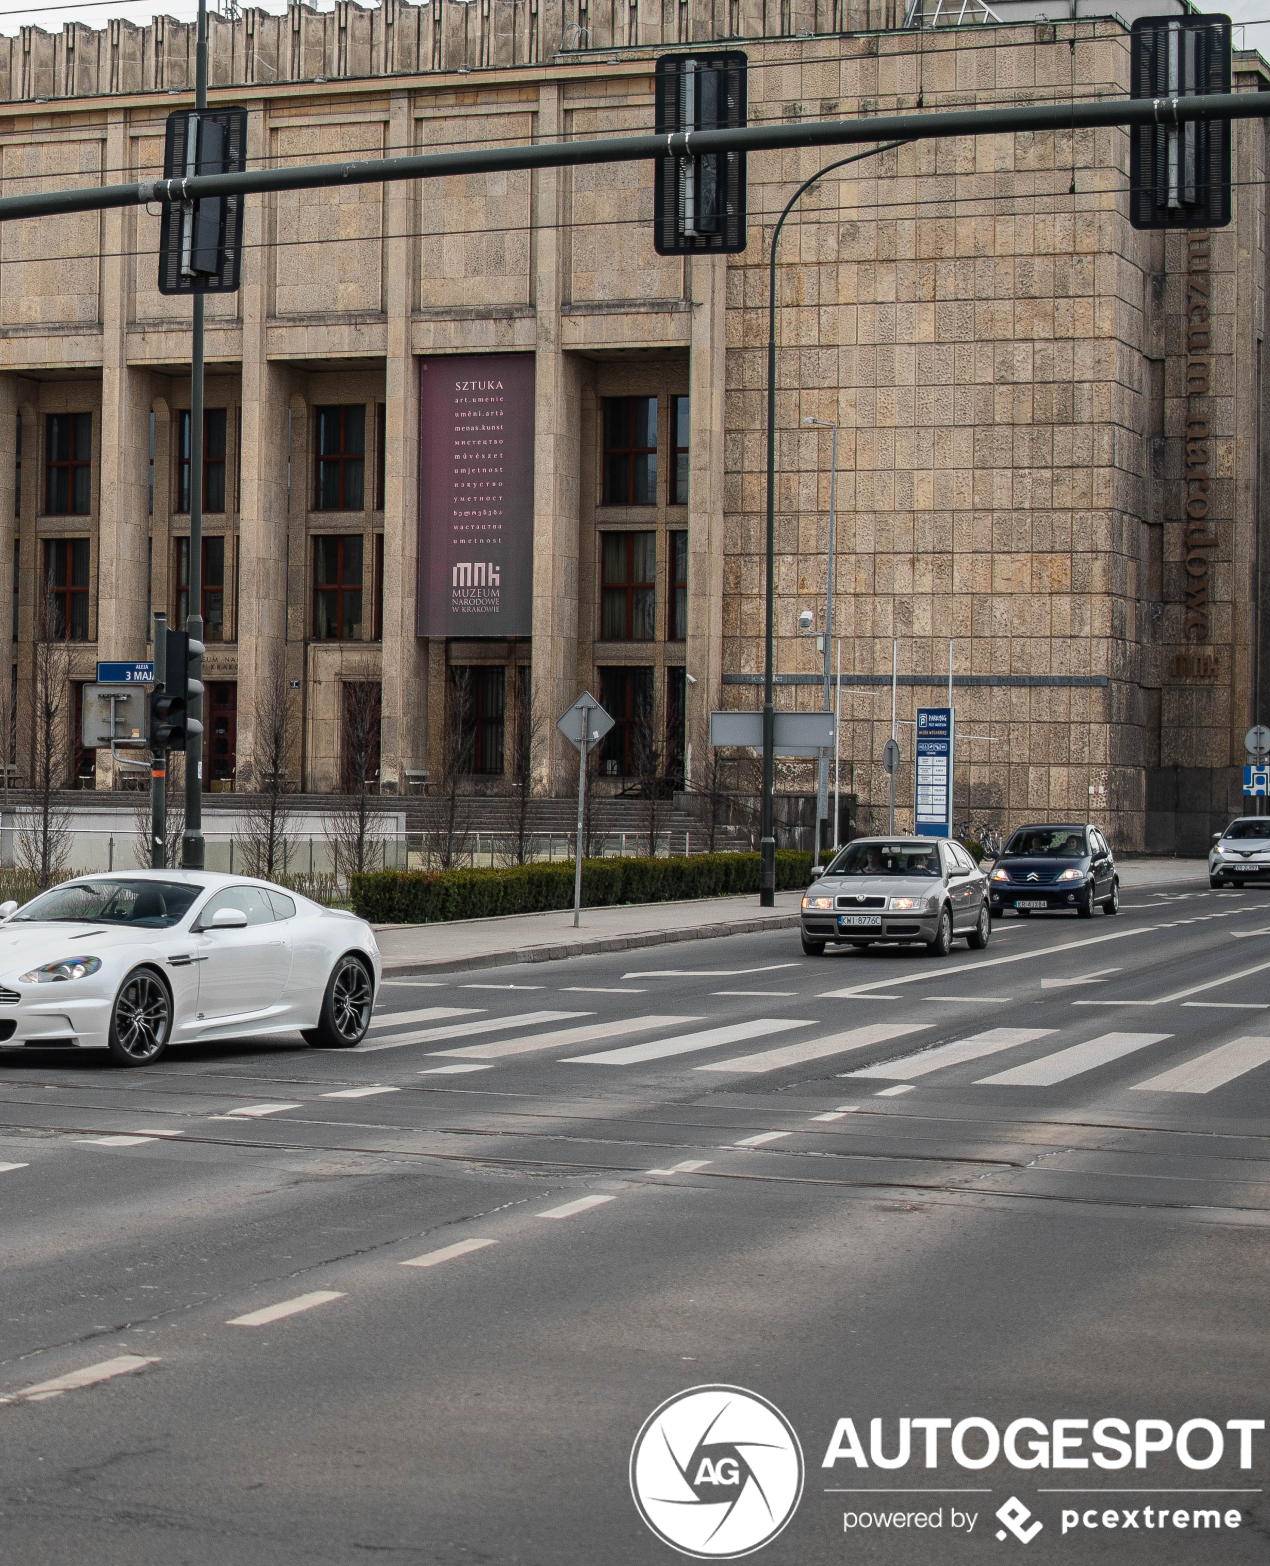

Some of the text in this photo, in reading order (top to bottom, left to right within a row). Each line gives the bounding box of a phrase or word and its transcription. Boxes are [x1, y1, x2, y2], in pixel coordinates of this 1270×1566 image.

[455, 380, 504, 391] SZTUKA
[1184, 413, 1219, 642] narodowe
[452, 588, 500, 598] MUZEUM
[452, 598, 500, 606] NARODOWE
[125, 671, 131, 681] 3
[928, 714, 947, 722] PARKING
[841, 916, 880, 925] KWI 8776C
